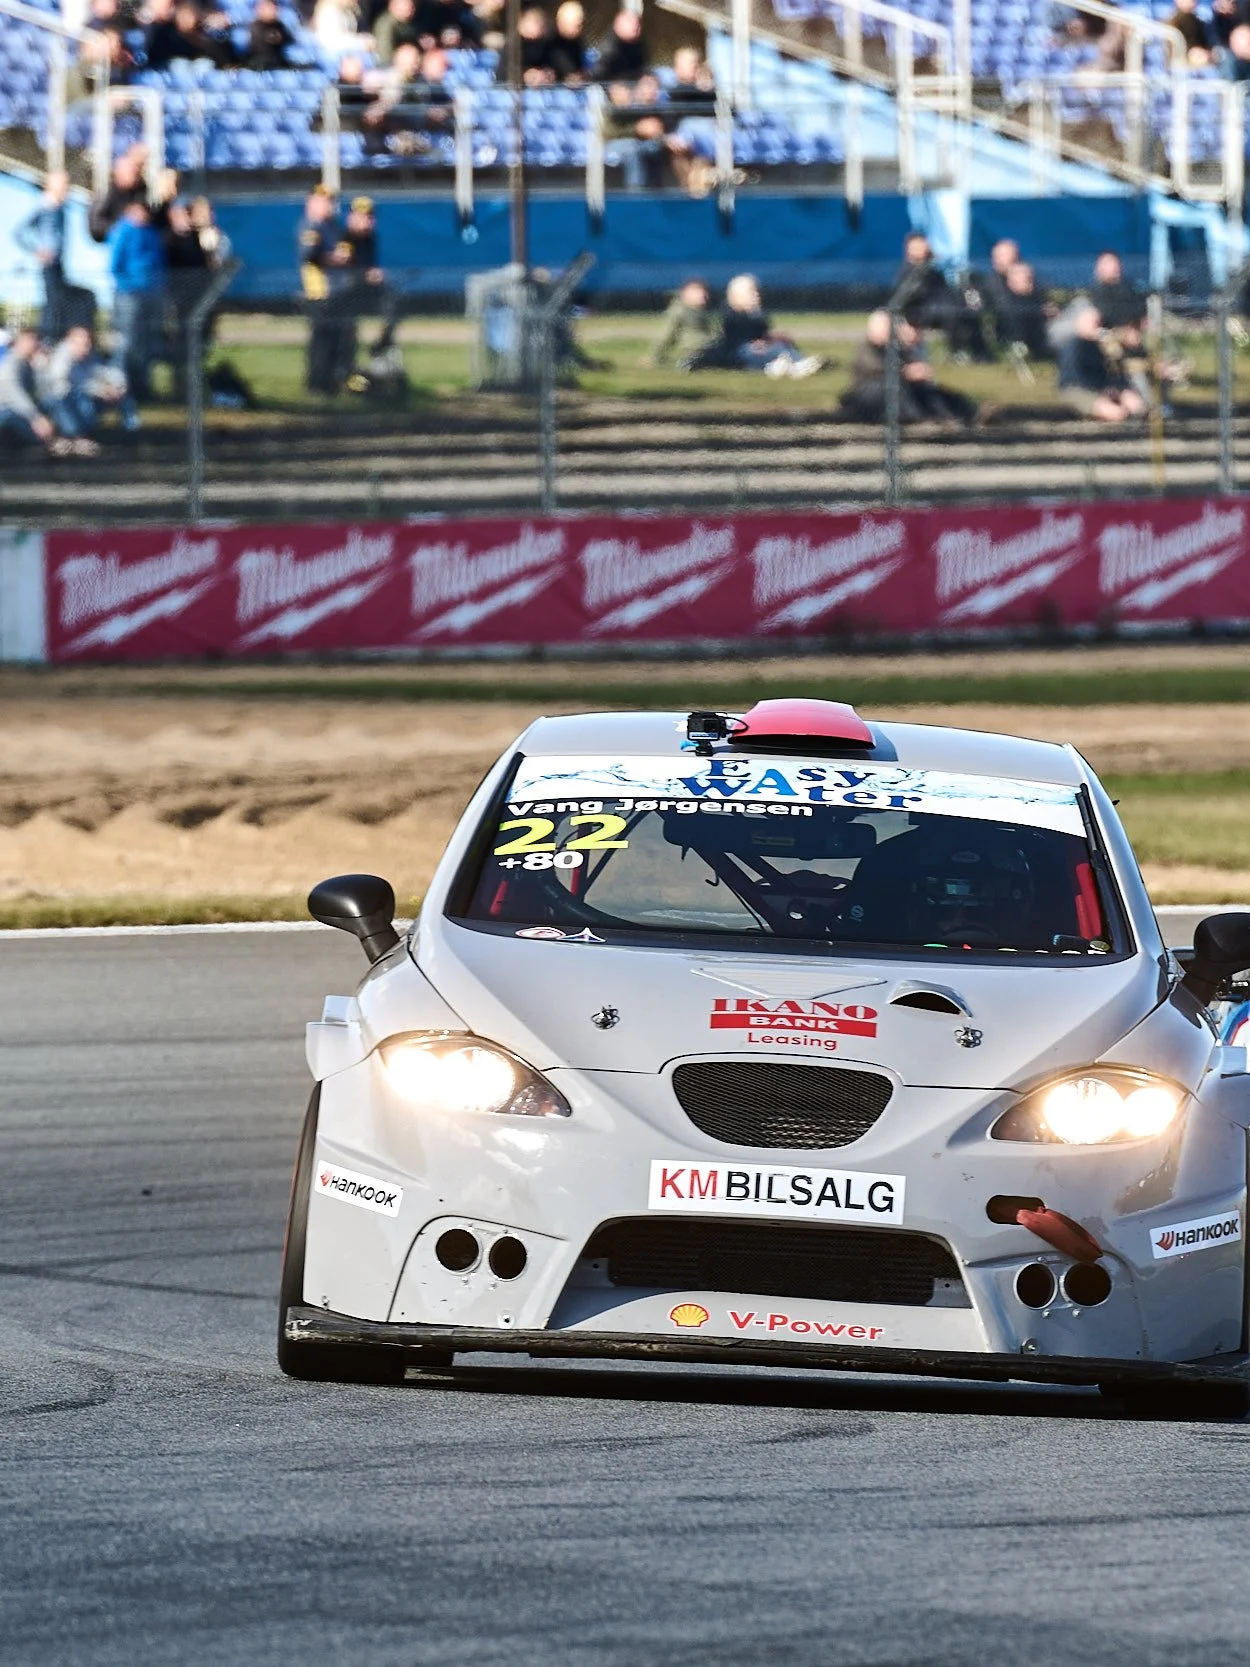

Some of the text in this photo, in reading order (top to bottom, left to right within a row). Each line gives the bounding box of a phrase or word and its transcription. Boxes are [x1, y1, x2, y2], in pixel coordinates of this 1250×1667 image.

[507, 798, 813, 817] Vang Jørgensen
[493, 814, 629, 856] 22
[499, 851, 584, 871] +80
[712, 999, 877, 1020] IKANO
[749, 1016, 839, 1030] BANK
[748, 1032, 838, 1050] Leasing
[730, 1311, 884, 1340] V-Power
